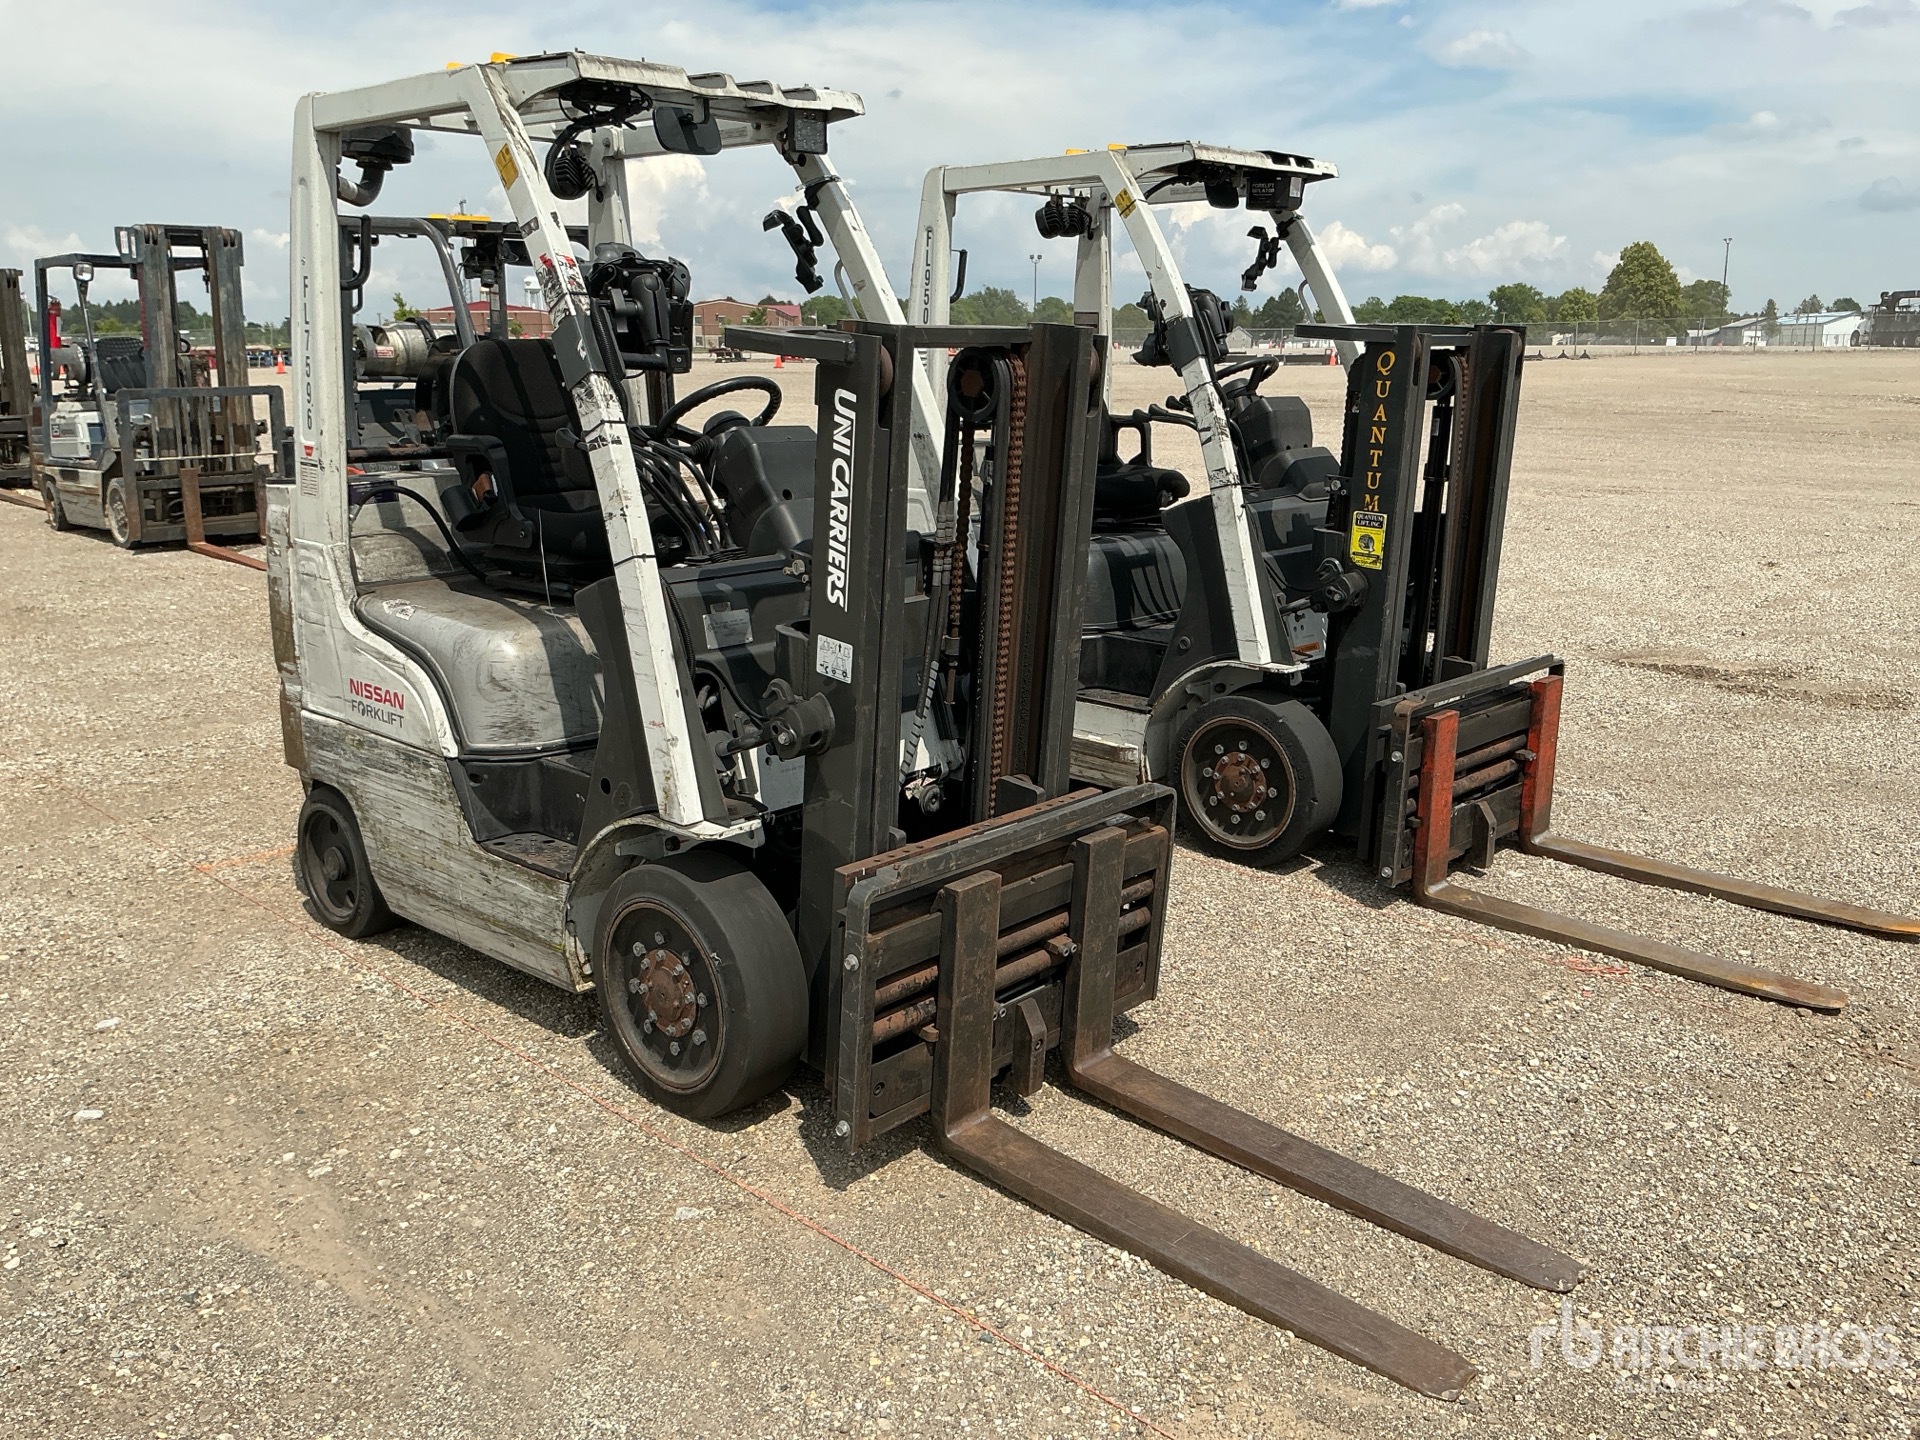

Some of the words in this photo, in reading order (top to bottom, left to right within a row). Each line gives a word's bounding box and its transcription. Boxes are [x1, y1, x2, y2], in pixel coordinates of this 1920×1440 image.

[1363, 350, 1396, 511] QUANTUM
[1356, 513, 1383, 521] QUANTUM
[349, 678, 404, 710] NISSAN
[351, 699, 405, 729] FORKLIFT
